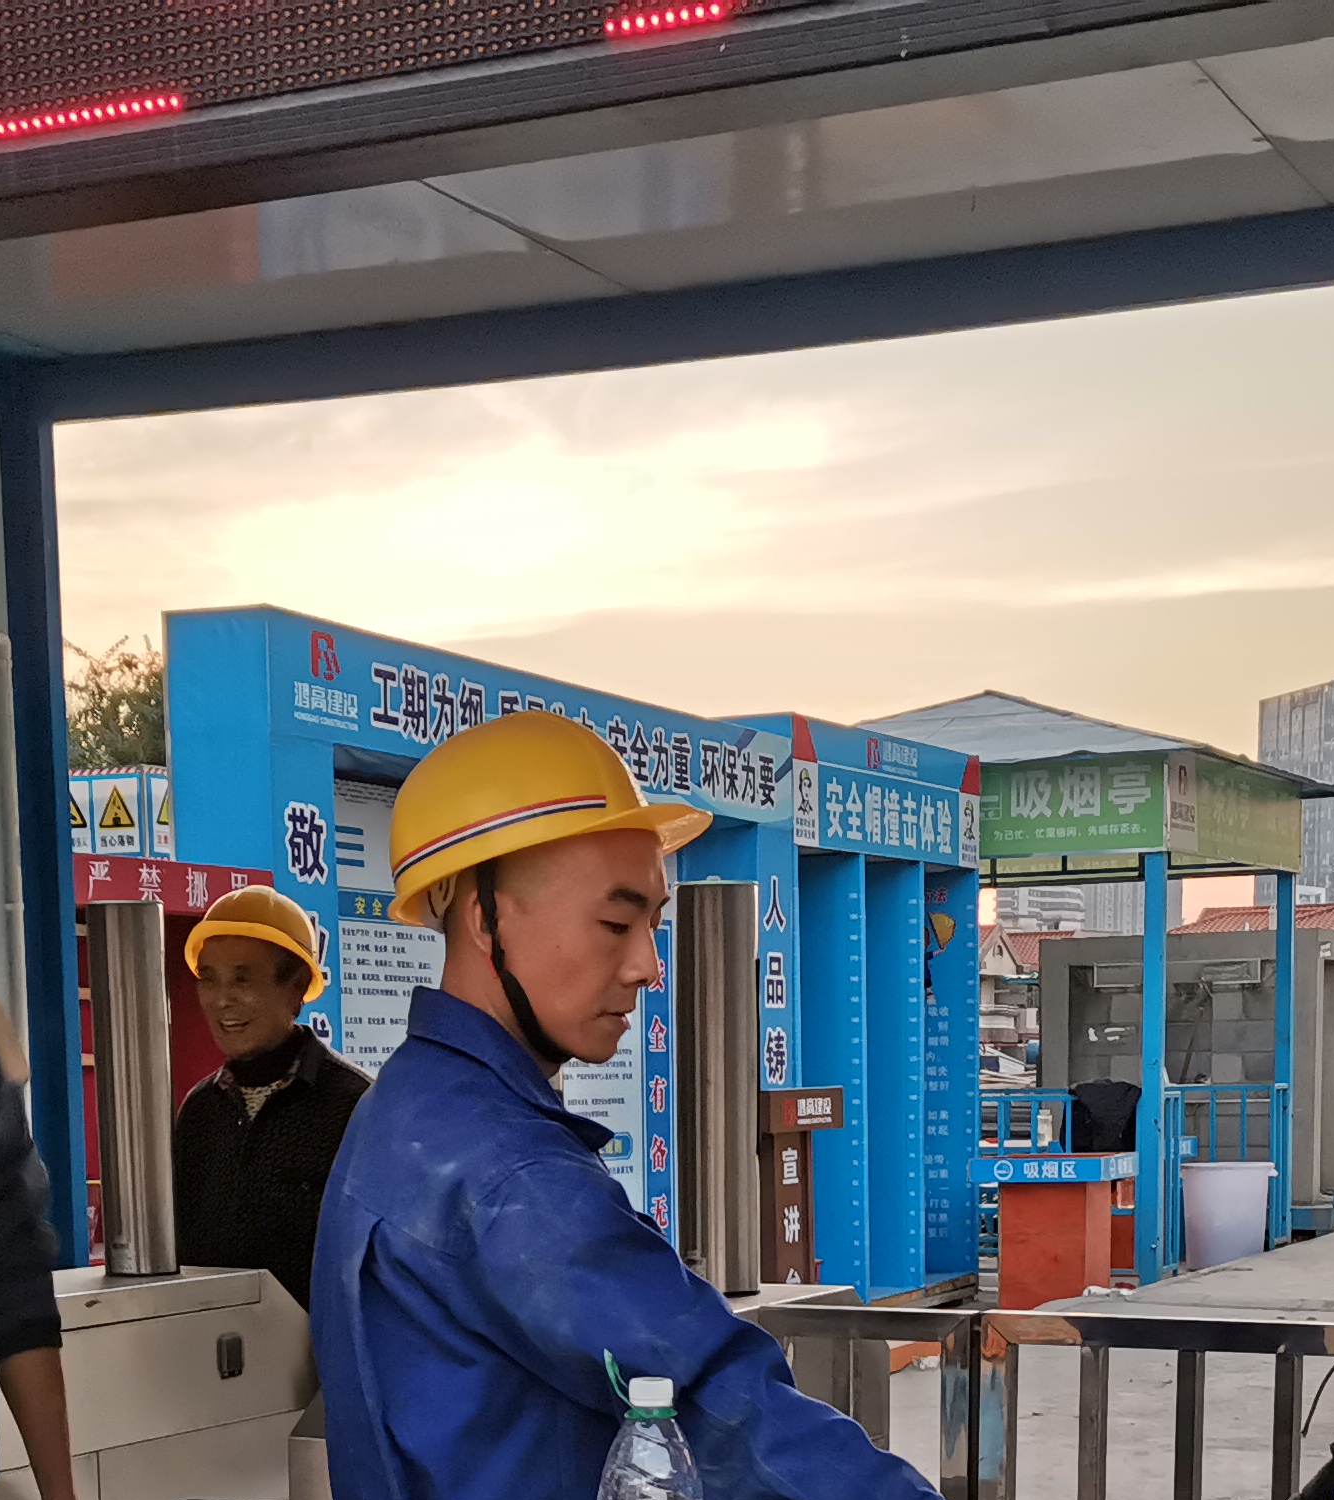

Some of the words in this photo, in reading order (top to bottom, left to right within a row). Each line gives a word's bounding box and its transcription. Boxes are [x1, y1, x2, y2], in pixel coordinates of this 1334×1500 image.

[371, 661, 485, 746] 工期为纲
[700, 738, 778, 808] 环保为要
[1009, 763, 1153, 820] 吸烟亭
[99, 834, 136, 848] 当心落物
[826, 775, 953, 856] 安全帽撞击体验
[1023, 1160, 1078, 1179] 吸烟区
